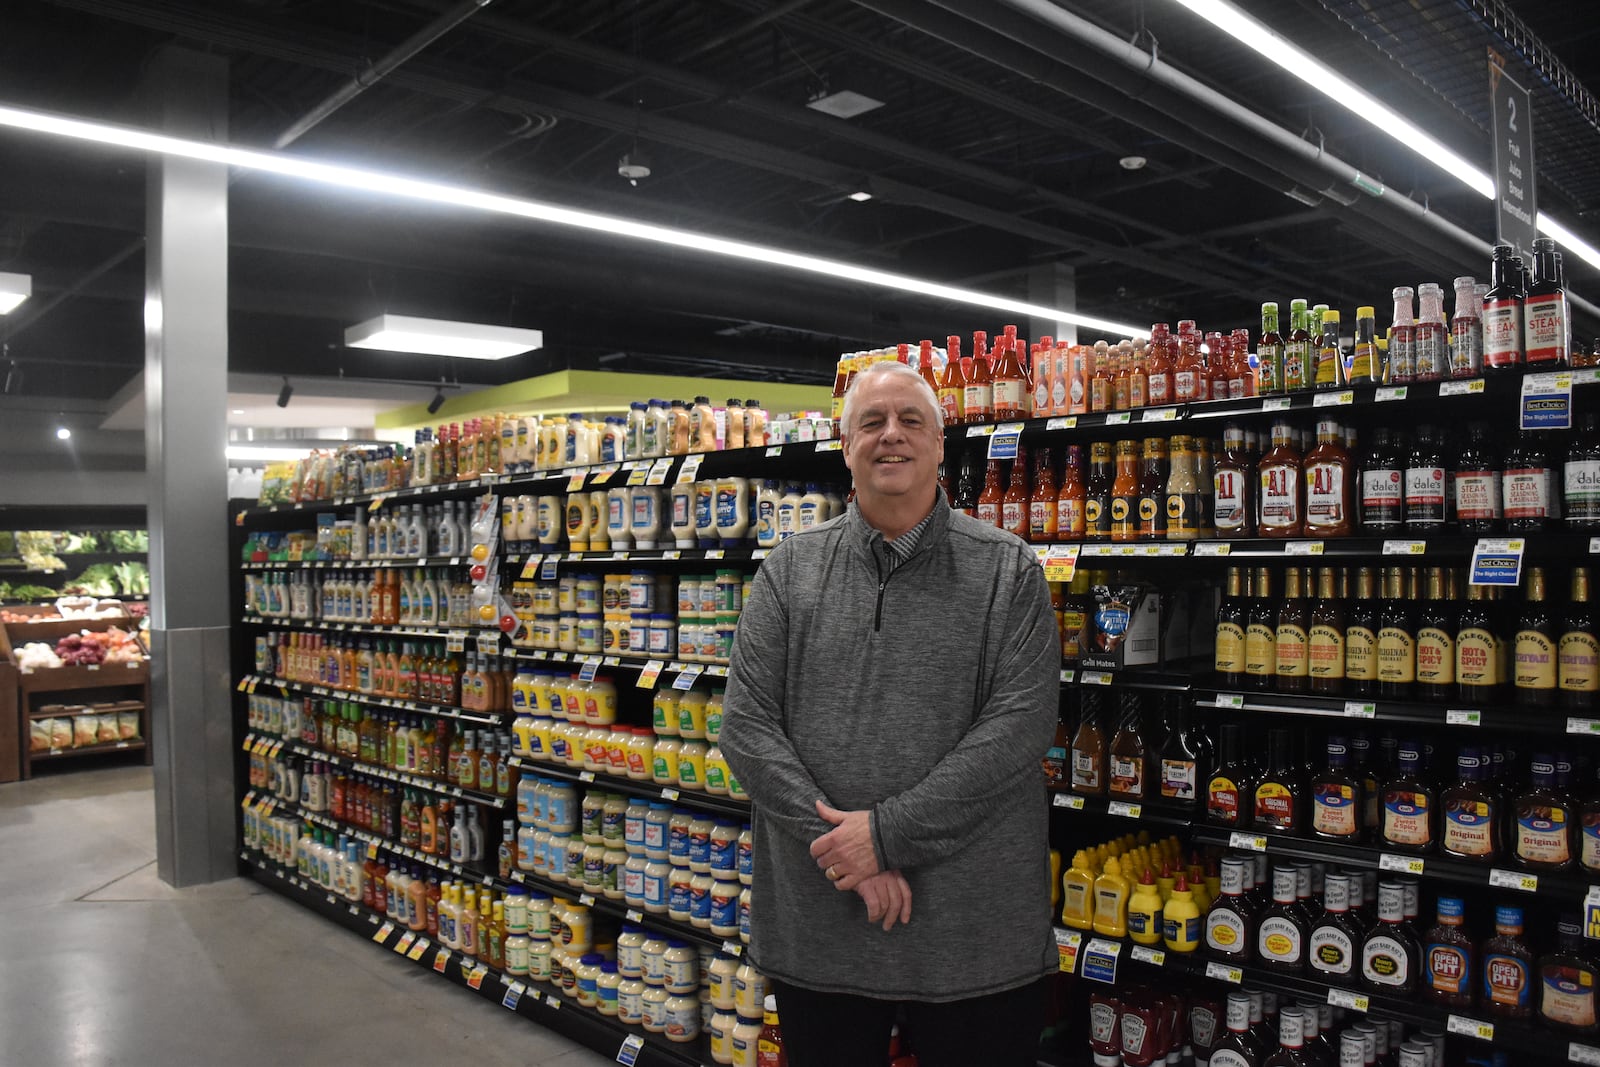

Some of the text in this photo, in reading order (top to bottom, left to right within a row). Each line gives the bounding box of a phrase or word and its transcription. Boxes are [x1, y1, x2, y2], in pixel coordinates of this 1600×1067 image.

[1508, 97, 1518, 132] 2
[1508, 160, 1522, 180] Juice
[1508, 180, 1524, 200] Bread
[1502, 197, 1532, 225] International
[1486, 322, 1516, 334] STEAK
[1529, 316, 1561, 330] STEAK
[1372, 480, 1398, 491] dale's
[1414, 478, 1441, 489] dale's
[1420, 646, 1435, 655] HOT
[1462, 646, 1479, 656] HOT
[1419, 655, 1442, 664] SPICY
[1461, 657, 1487, 666] SPICY
[1216, 792, 1235, 801] ORIGINAL
[1265, 798, 1288, 807] ORIGINAL
[1328, 815, 1345, 823] Spicy
[1399, 822, 1418, 831] Spicy
[1450, 830, 1485, 840] Original
[1523, 837, 1560, 847] Original
[1521, 879, 1536, 888] 255
[1434, 953, 1459, 965] OPEN
[1434, 963, 1456, 976] PIT
[1492, 964, 1518, 976] OPEN
[1492, 974, 1517, 986] PIT
